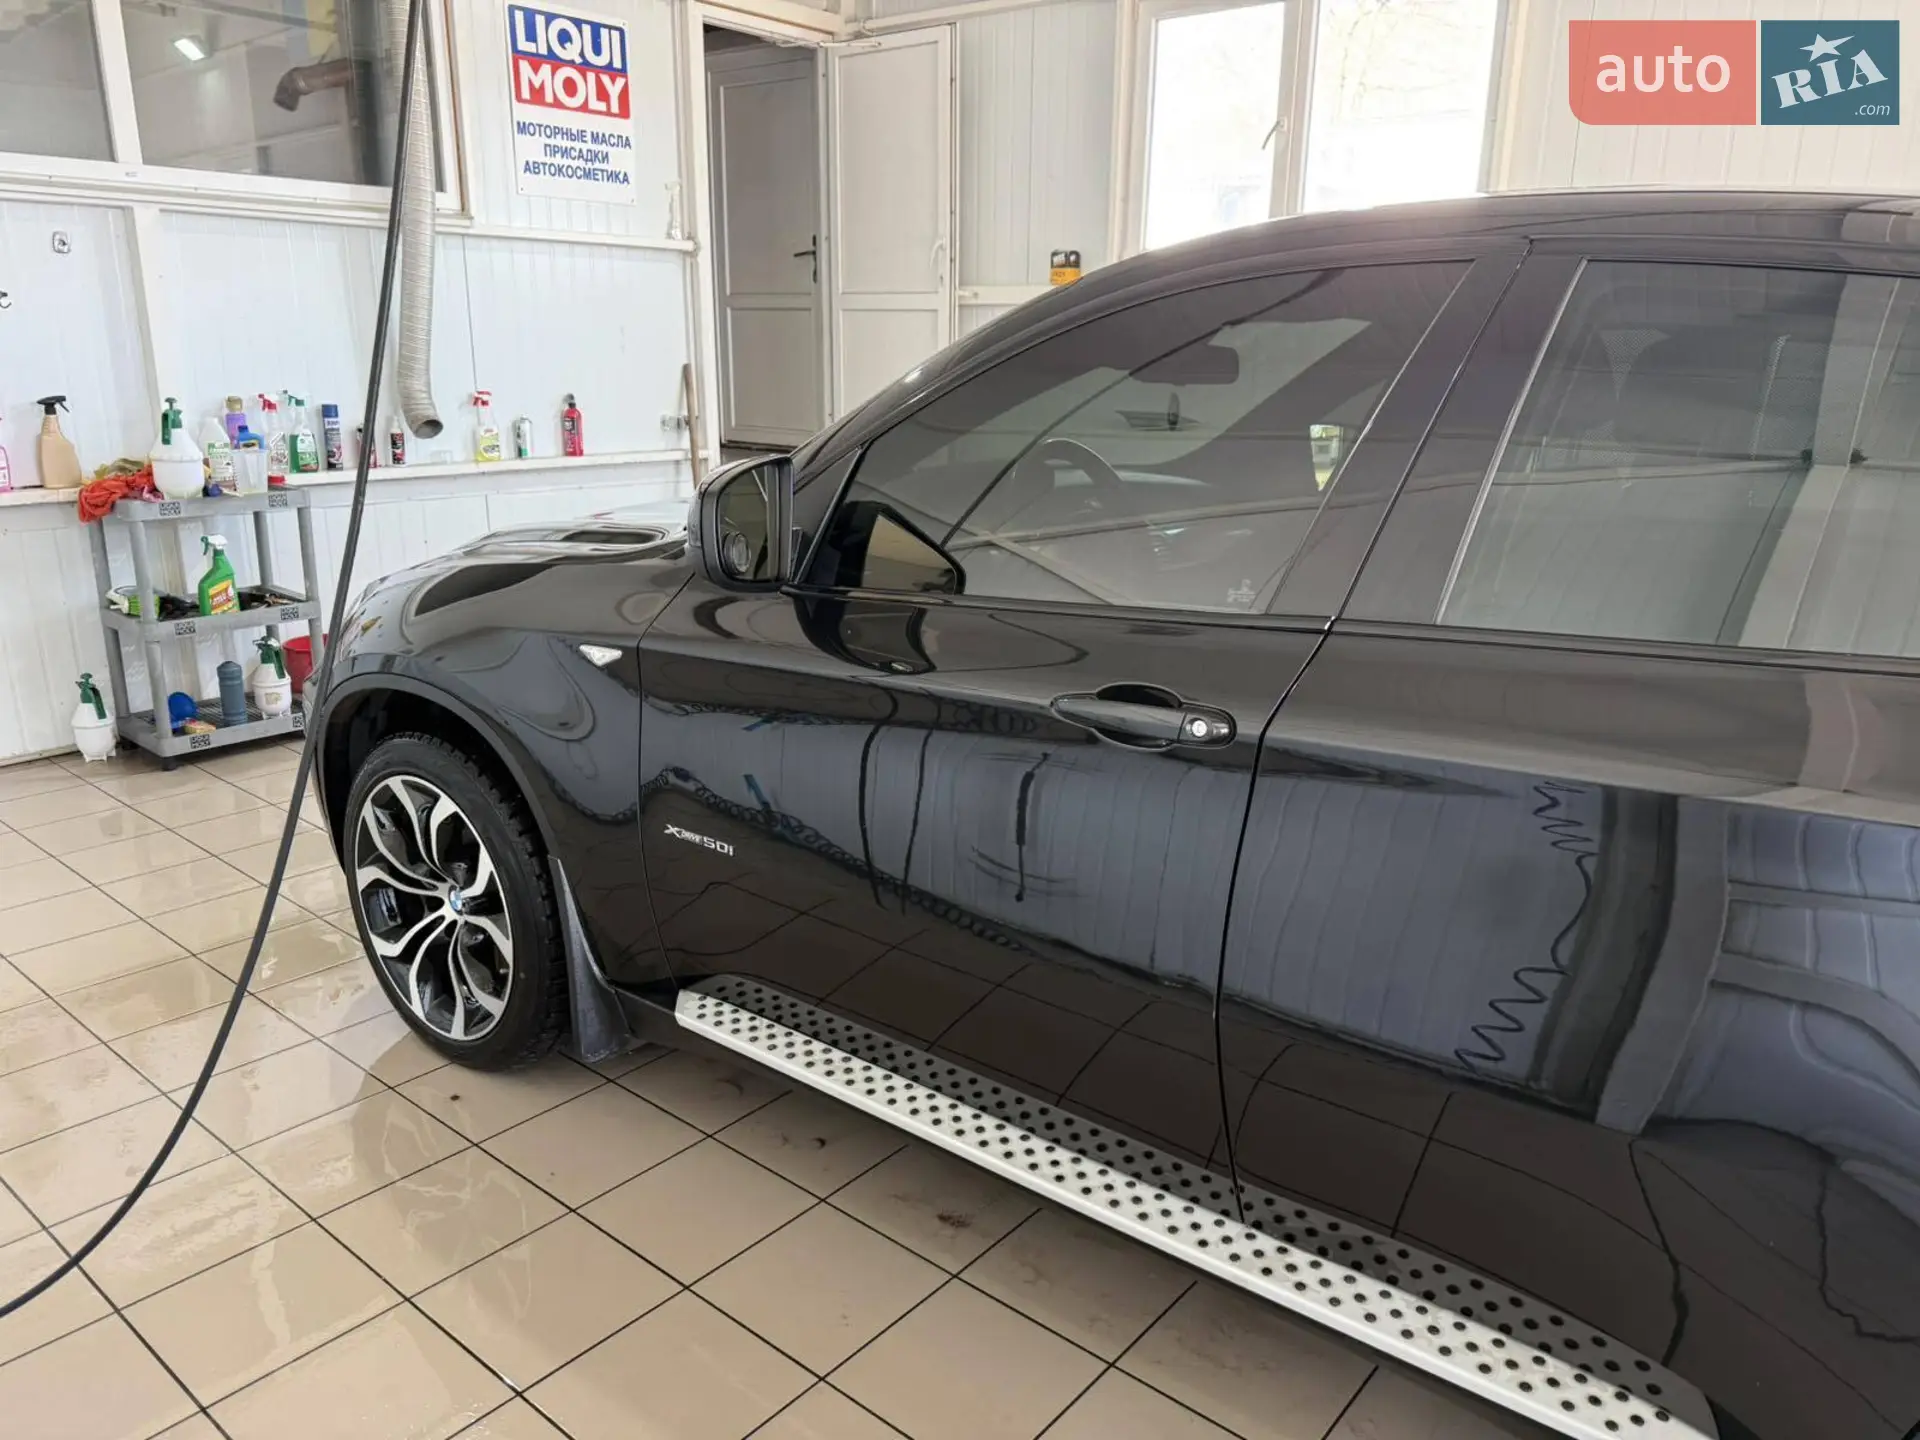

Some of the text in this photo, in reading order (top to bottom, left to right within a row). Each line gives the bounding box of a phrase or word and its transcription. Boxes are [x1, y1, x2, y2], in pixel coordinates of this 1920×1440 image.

[514, 9, 623, 69] LIQUI
[518, 59, 627, 114] MOLY
[516, 120, 632, 149] МОТОРНЫЕ МАСЛА
[543, 142, 610, 165] ПРИСАДКИ
[523, 159, 631, 186] АВТОКОСМЕТИКА
